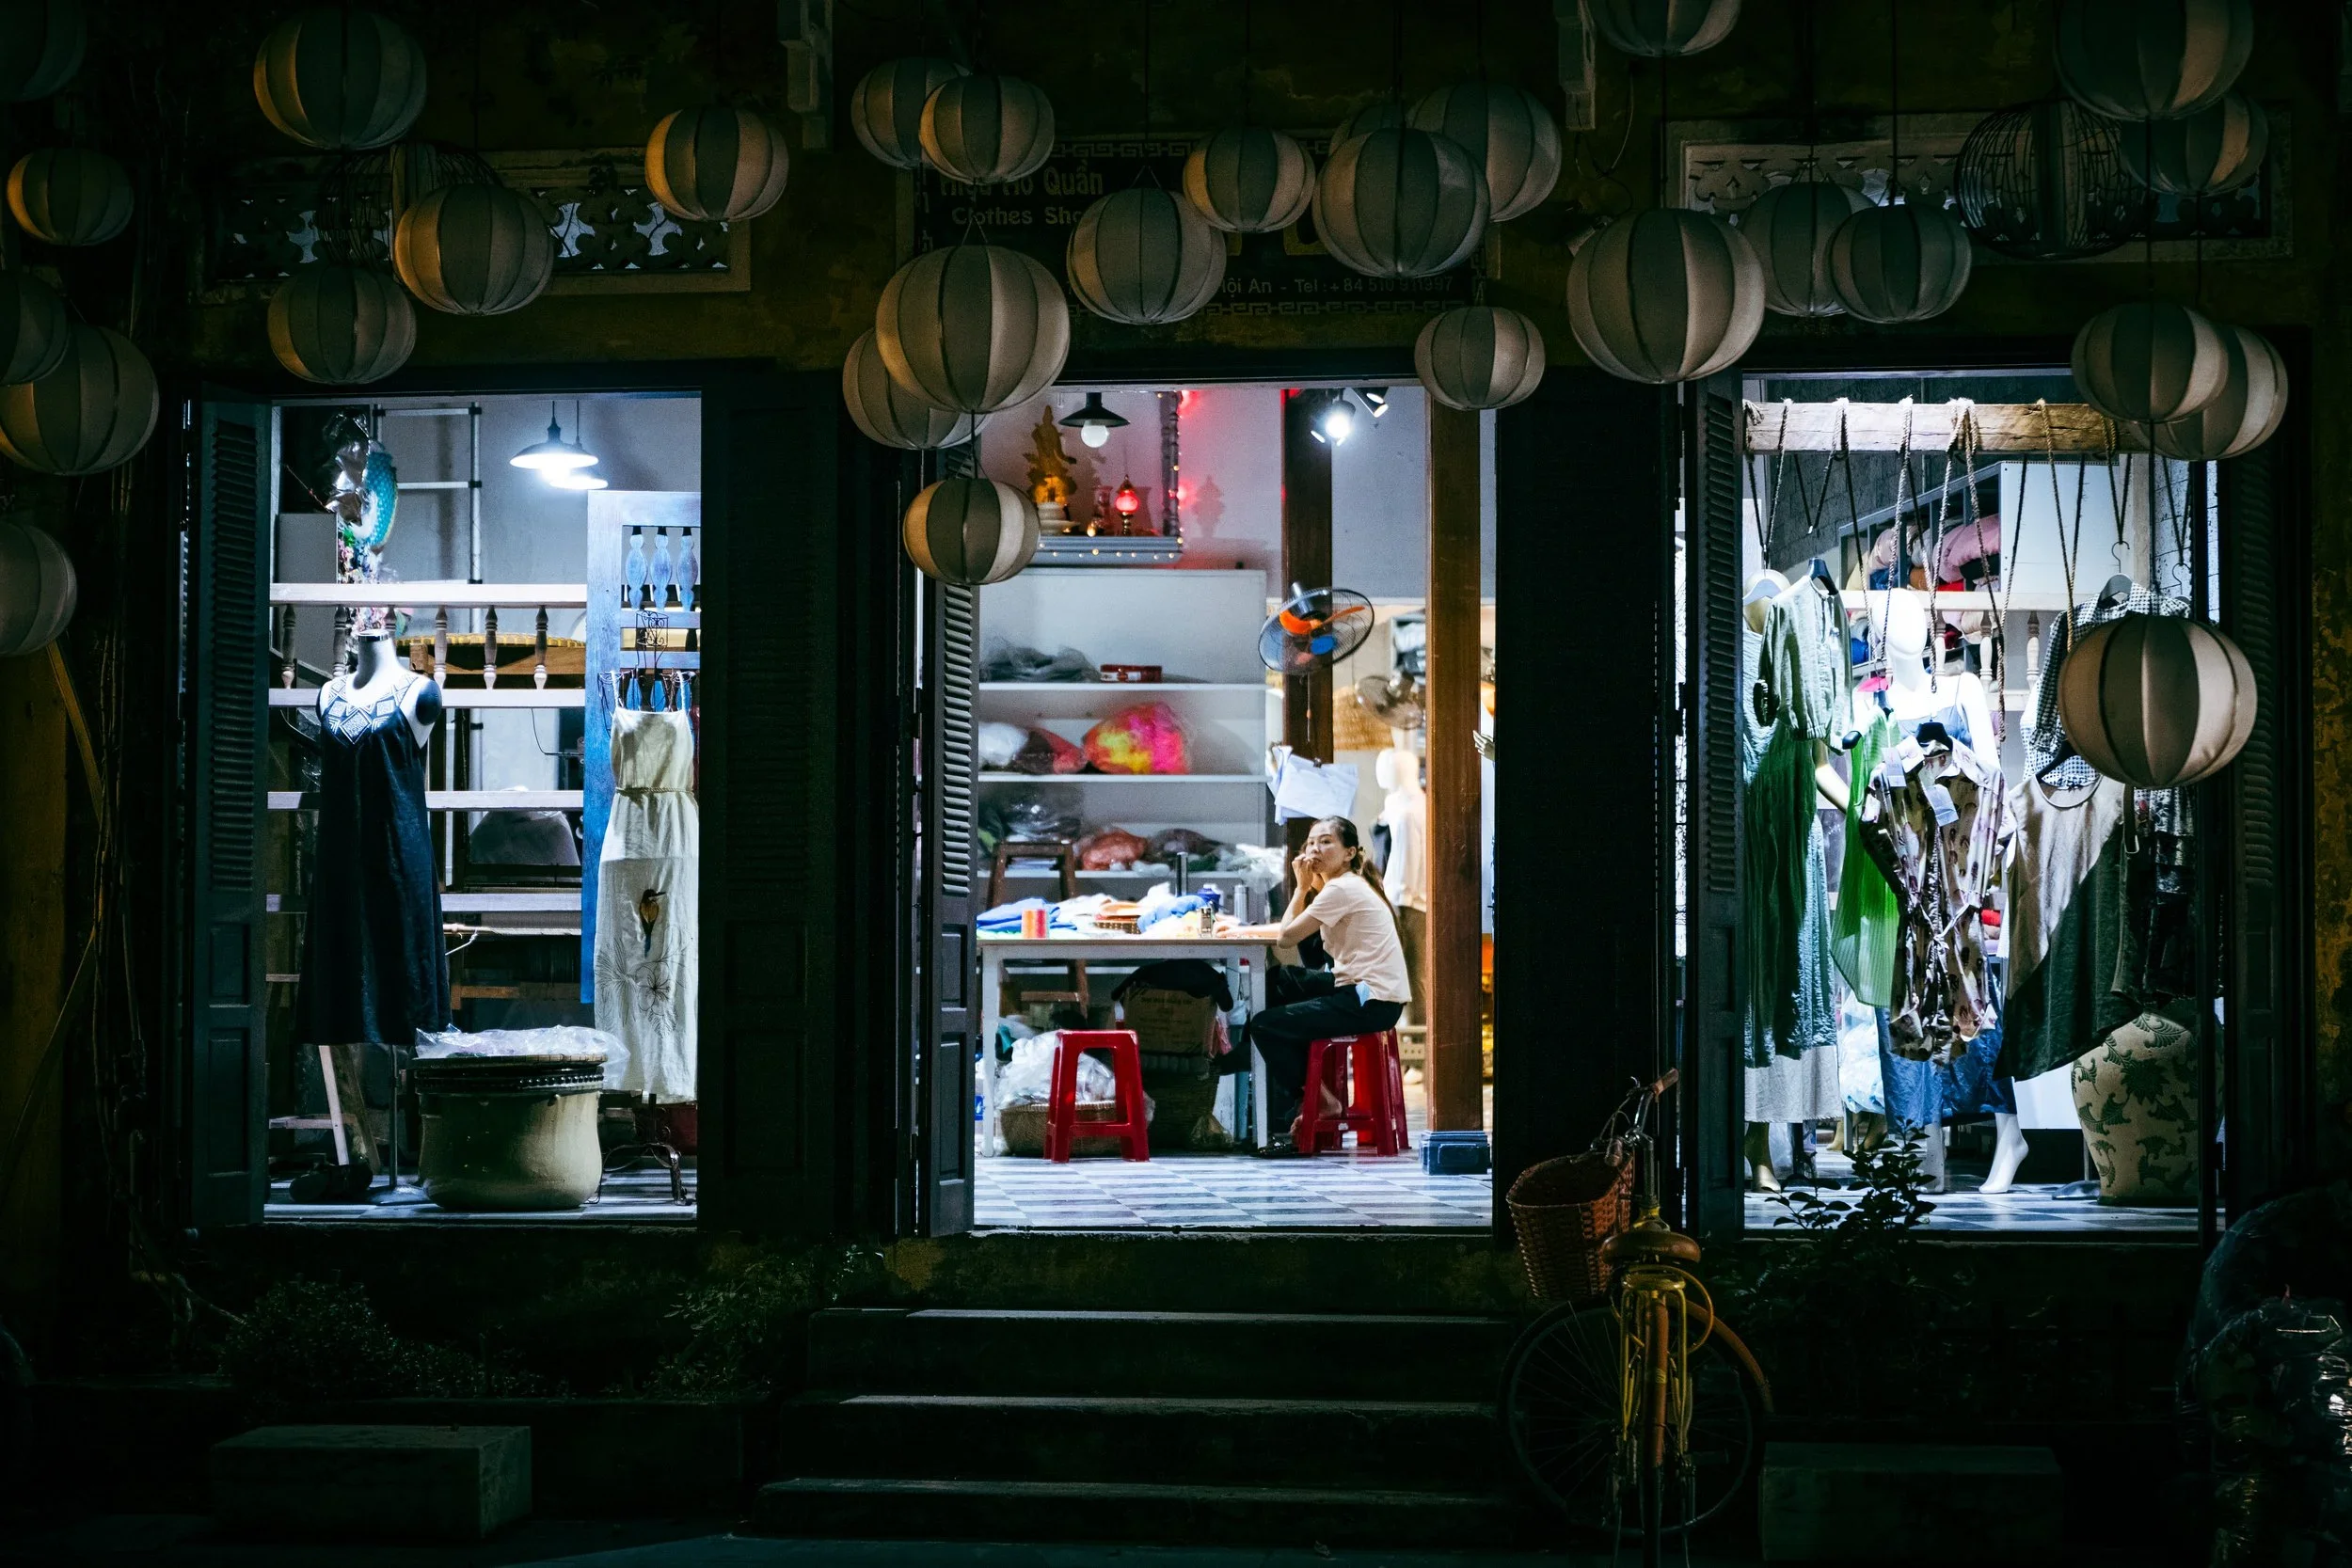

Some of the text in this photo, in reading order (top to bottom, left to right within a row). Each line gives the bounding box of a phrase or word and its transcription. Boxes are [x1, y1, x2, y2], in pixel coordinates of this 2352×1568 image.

[952, 206, 1033, 226] Clothes
[1248, 277, 1272, 293] An
[1294, 277, 1318, 293] Tel
